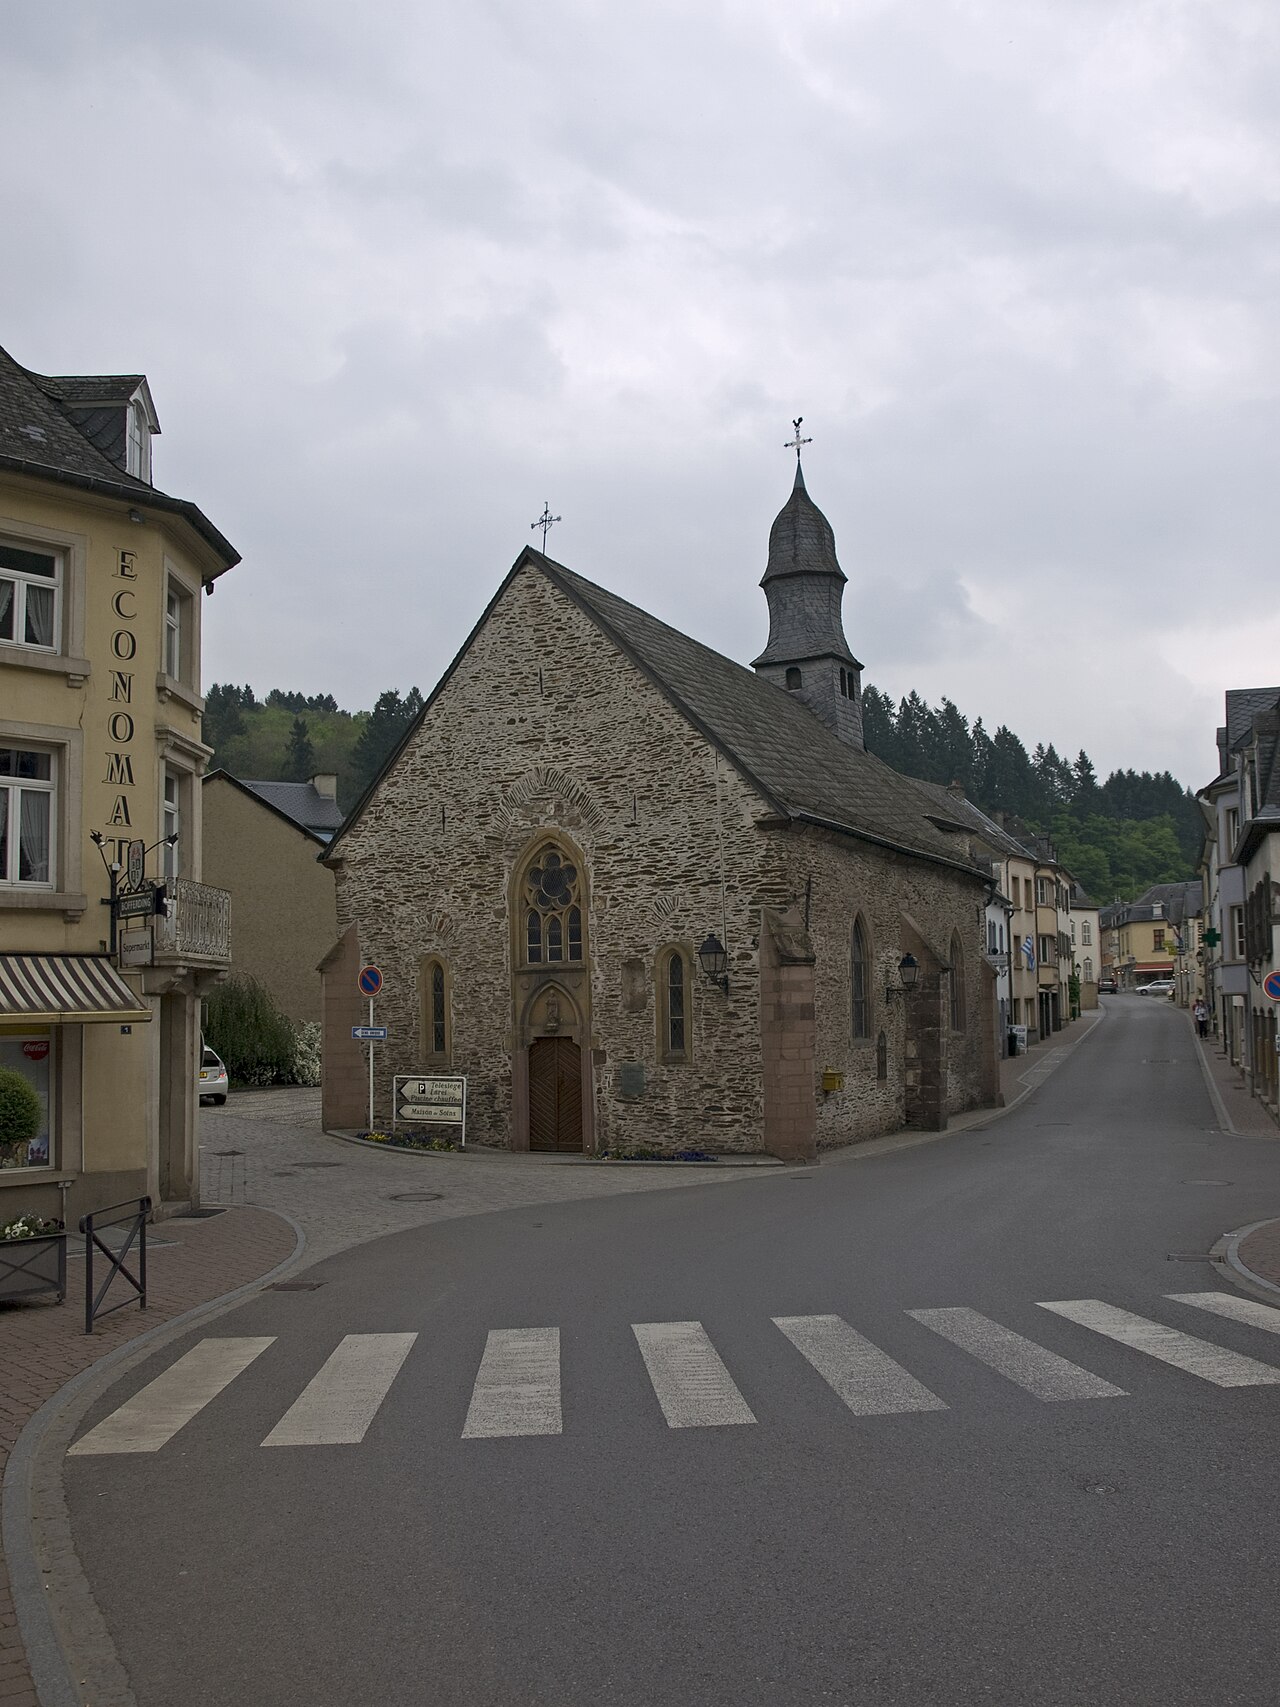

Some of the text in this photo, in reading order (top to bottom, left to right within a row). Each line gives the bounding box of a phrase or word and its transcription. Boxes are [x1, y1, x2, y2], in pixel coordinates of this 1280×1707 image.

[102, 547, 138, 870] ECONOMAT
[121, 898, 151, 911] BOFFERDING
[123, 940, 150, 953] Supermarkt
